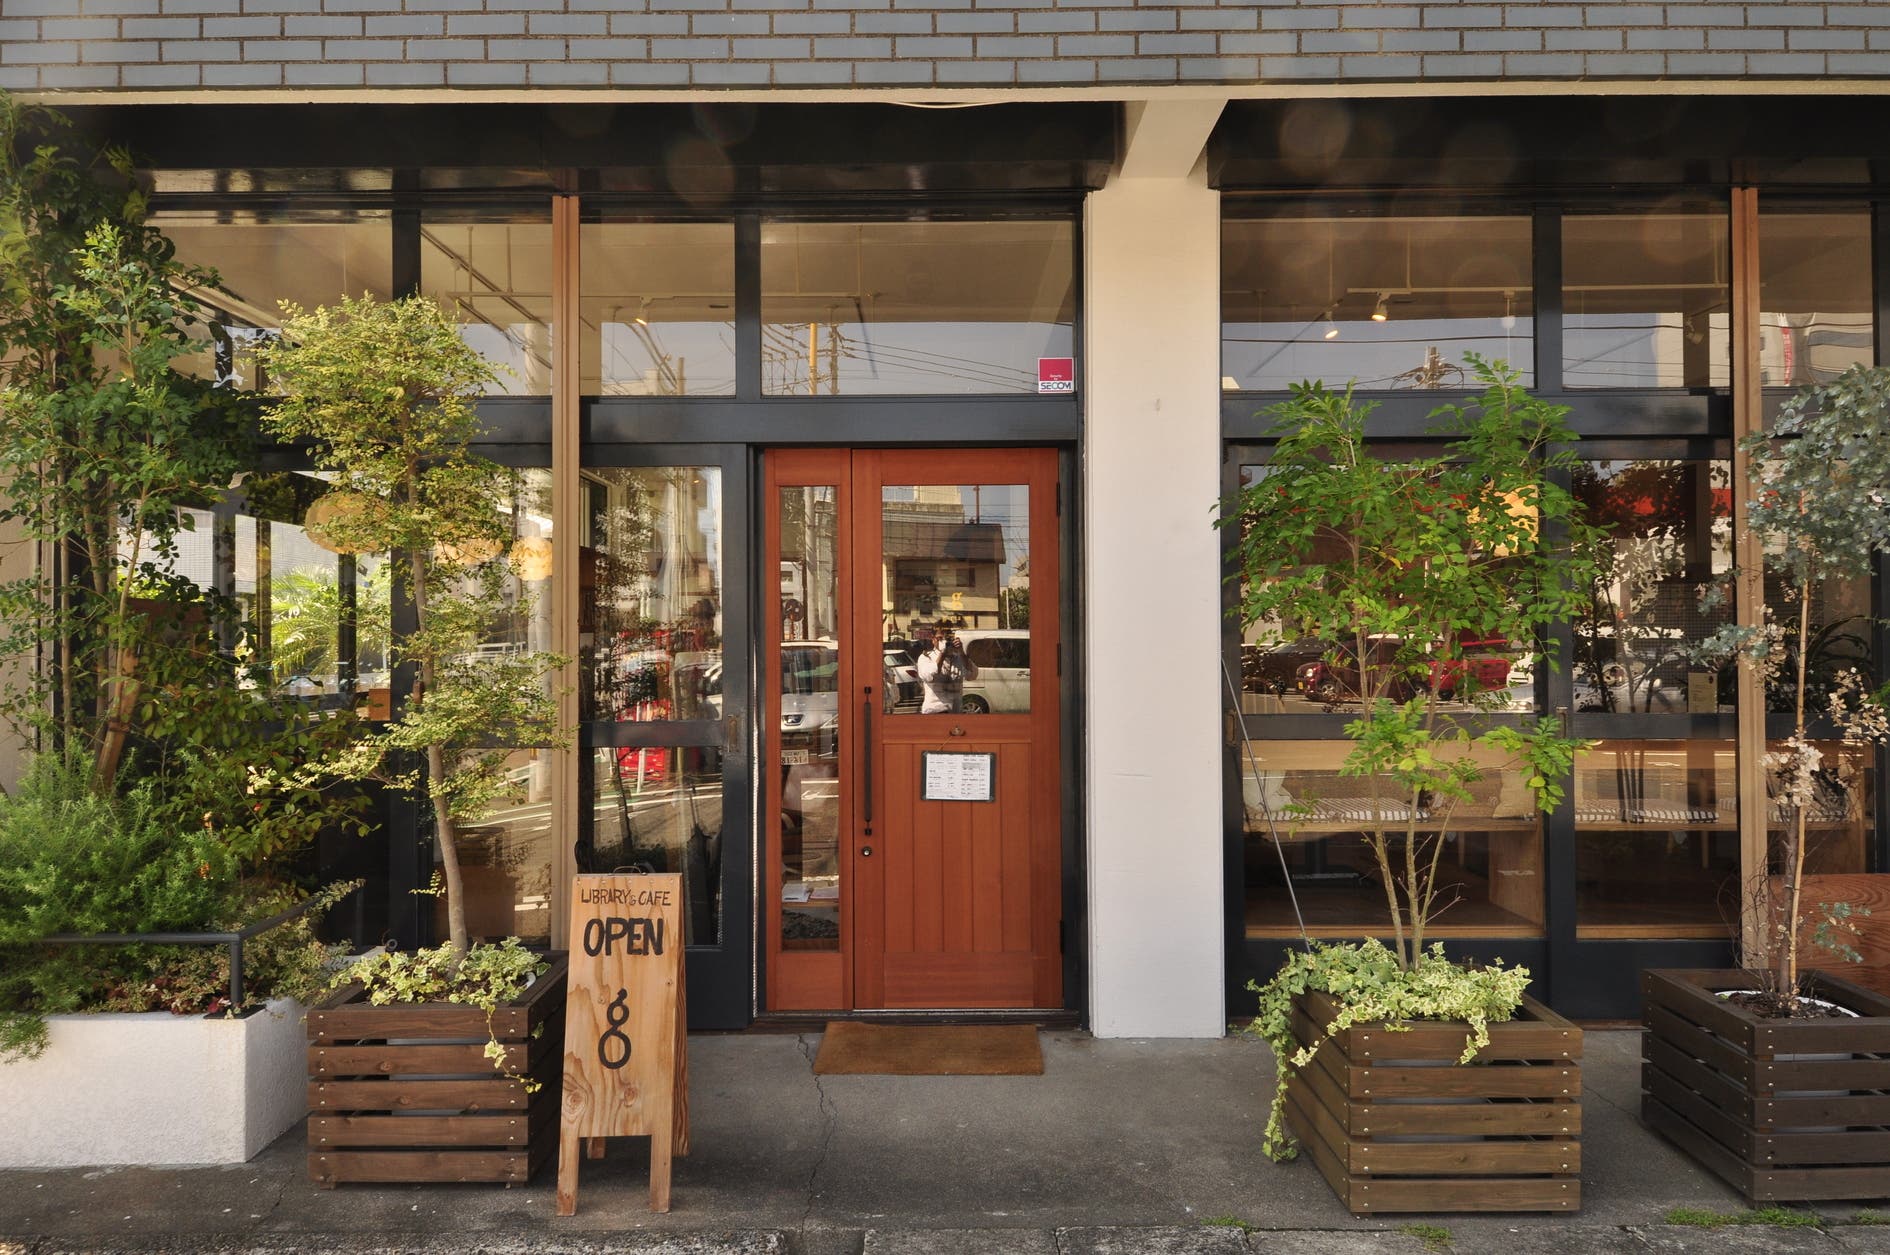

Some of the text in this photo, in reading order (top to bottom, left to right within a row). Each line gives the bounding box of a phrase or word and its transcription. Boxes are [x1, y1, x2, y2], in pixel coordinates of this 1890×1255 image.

[1040, 381, 1072, 390] SECOM
[581, 888, 631, 904] LIBRARY
[638, 890, 671, 906] CAFE
[583, 917, 664, 957] OPEN
